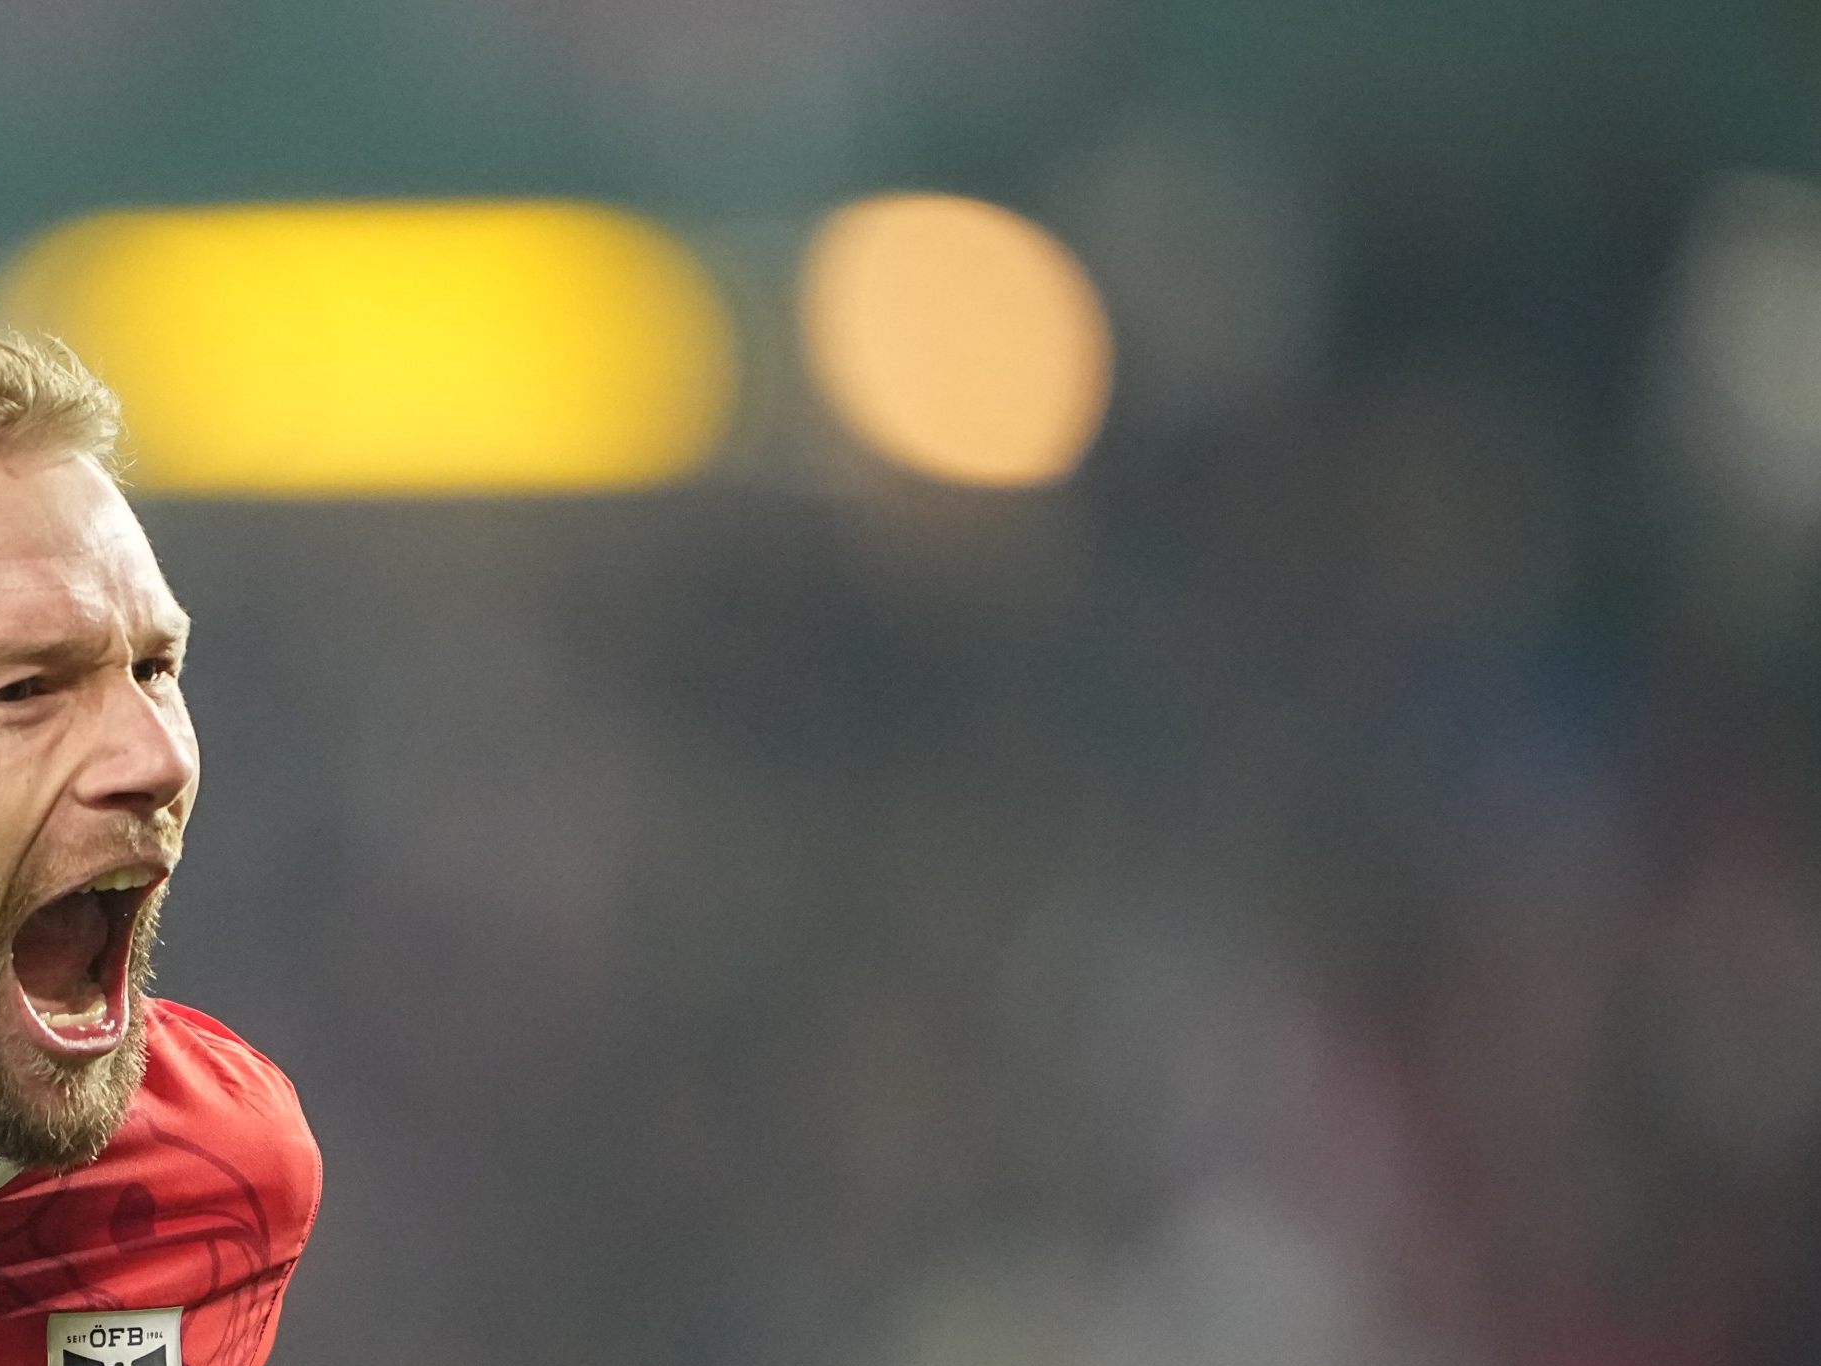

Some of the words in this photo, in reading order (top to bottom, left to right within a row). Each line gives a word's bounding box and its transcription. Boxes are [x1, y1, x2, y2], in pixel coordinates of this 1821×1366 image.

[67, 1335, 86, 1343] SEIT
[90, 1324, 143, 1348] ÖFB
[146, 1331, 163, 1340] 1904
